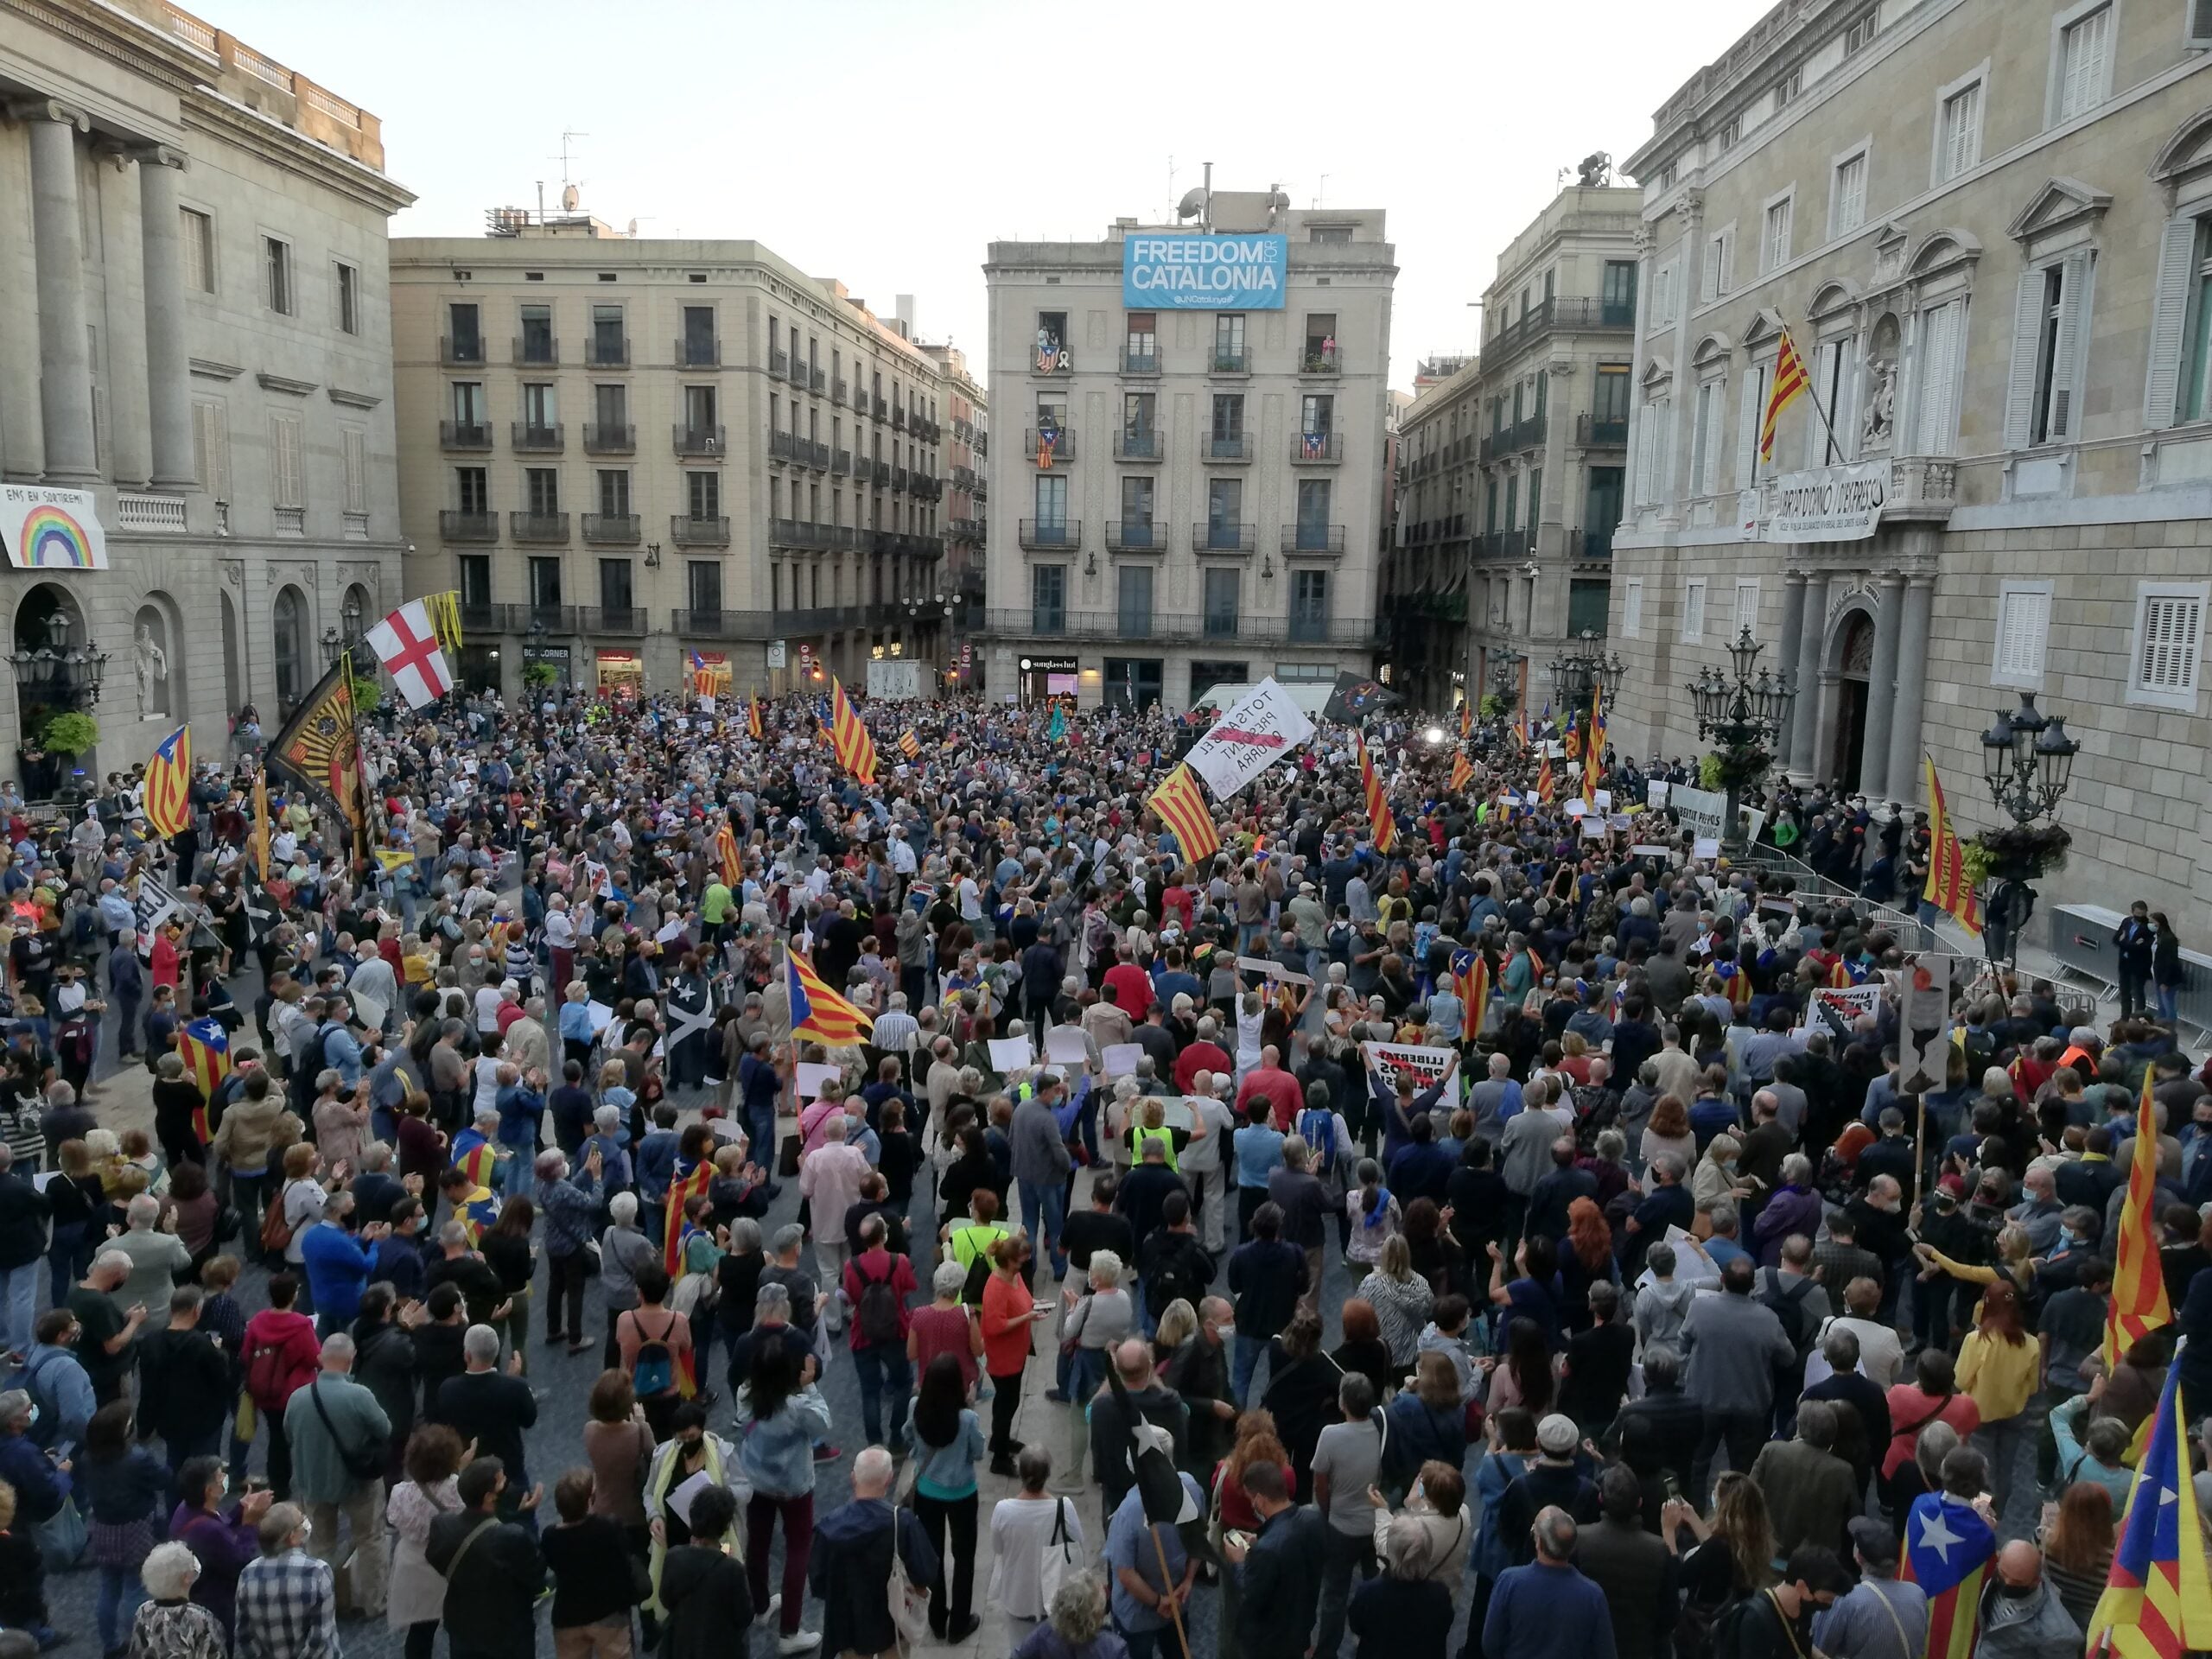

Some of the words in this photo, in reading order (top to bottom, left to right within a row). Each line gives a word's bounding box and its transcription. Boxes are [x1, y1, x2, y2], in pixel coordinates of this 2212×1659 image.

[1134, 240, 1262, 264] FREEDOM
[1264, 240, 1278, 263] FOR
[1132, 264, 1276, 290] CATALONIA
[6, 489, 24, 502] ENS
[28, 491, 39, 502] EN
[1033, 659, 1063, 670] sunglass
[1064, 660, 1076, 669] hut
